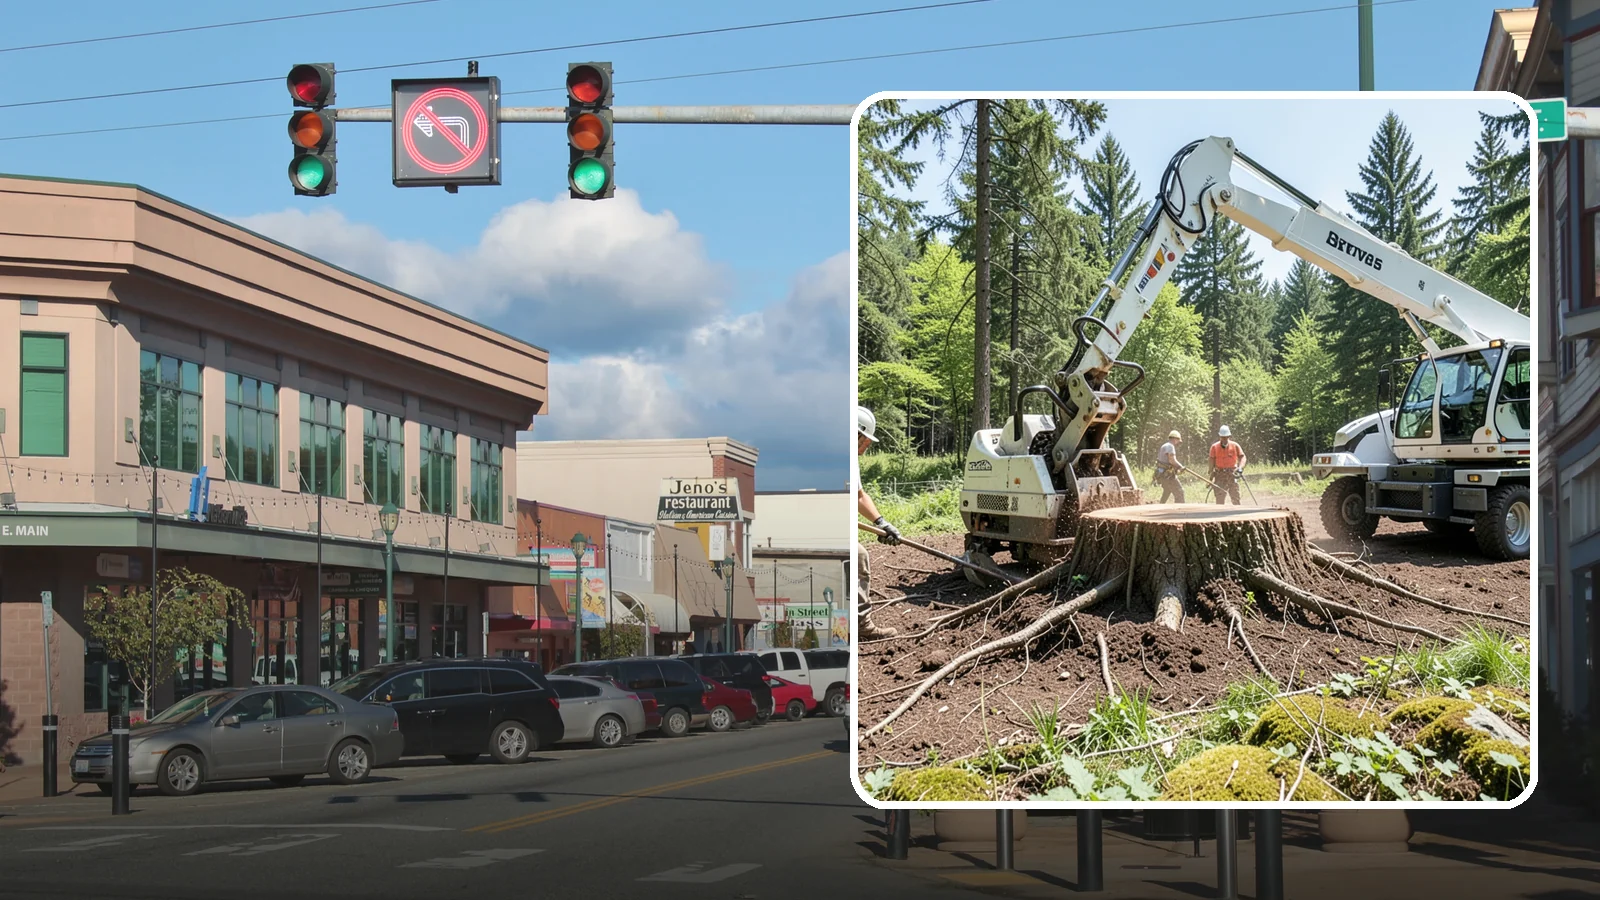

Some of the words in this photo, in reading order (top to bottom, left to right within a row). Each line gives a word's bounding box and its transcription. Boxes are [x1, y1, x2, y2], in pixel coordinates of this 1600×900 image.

[670, 480, 727, 494] Jeno's
[665, 496, 731, 509] restaurant
[658, 510, 681, 519] Italian
[686, 510, 714, 519] American
[715, 509, 738, 519] Cuisine
[2, 525, 13, 536] E.
[15, 525, 49, 536] MAIN
[797, 607, 828, 617] Street
[790, 619, 824, 628] lass
